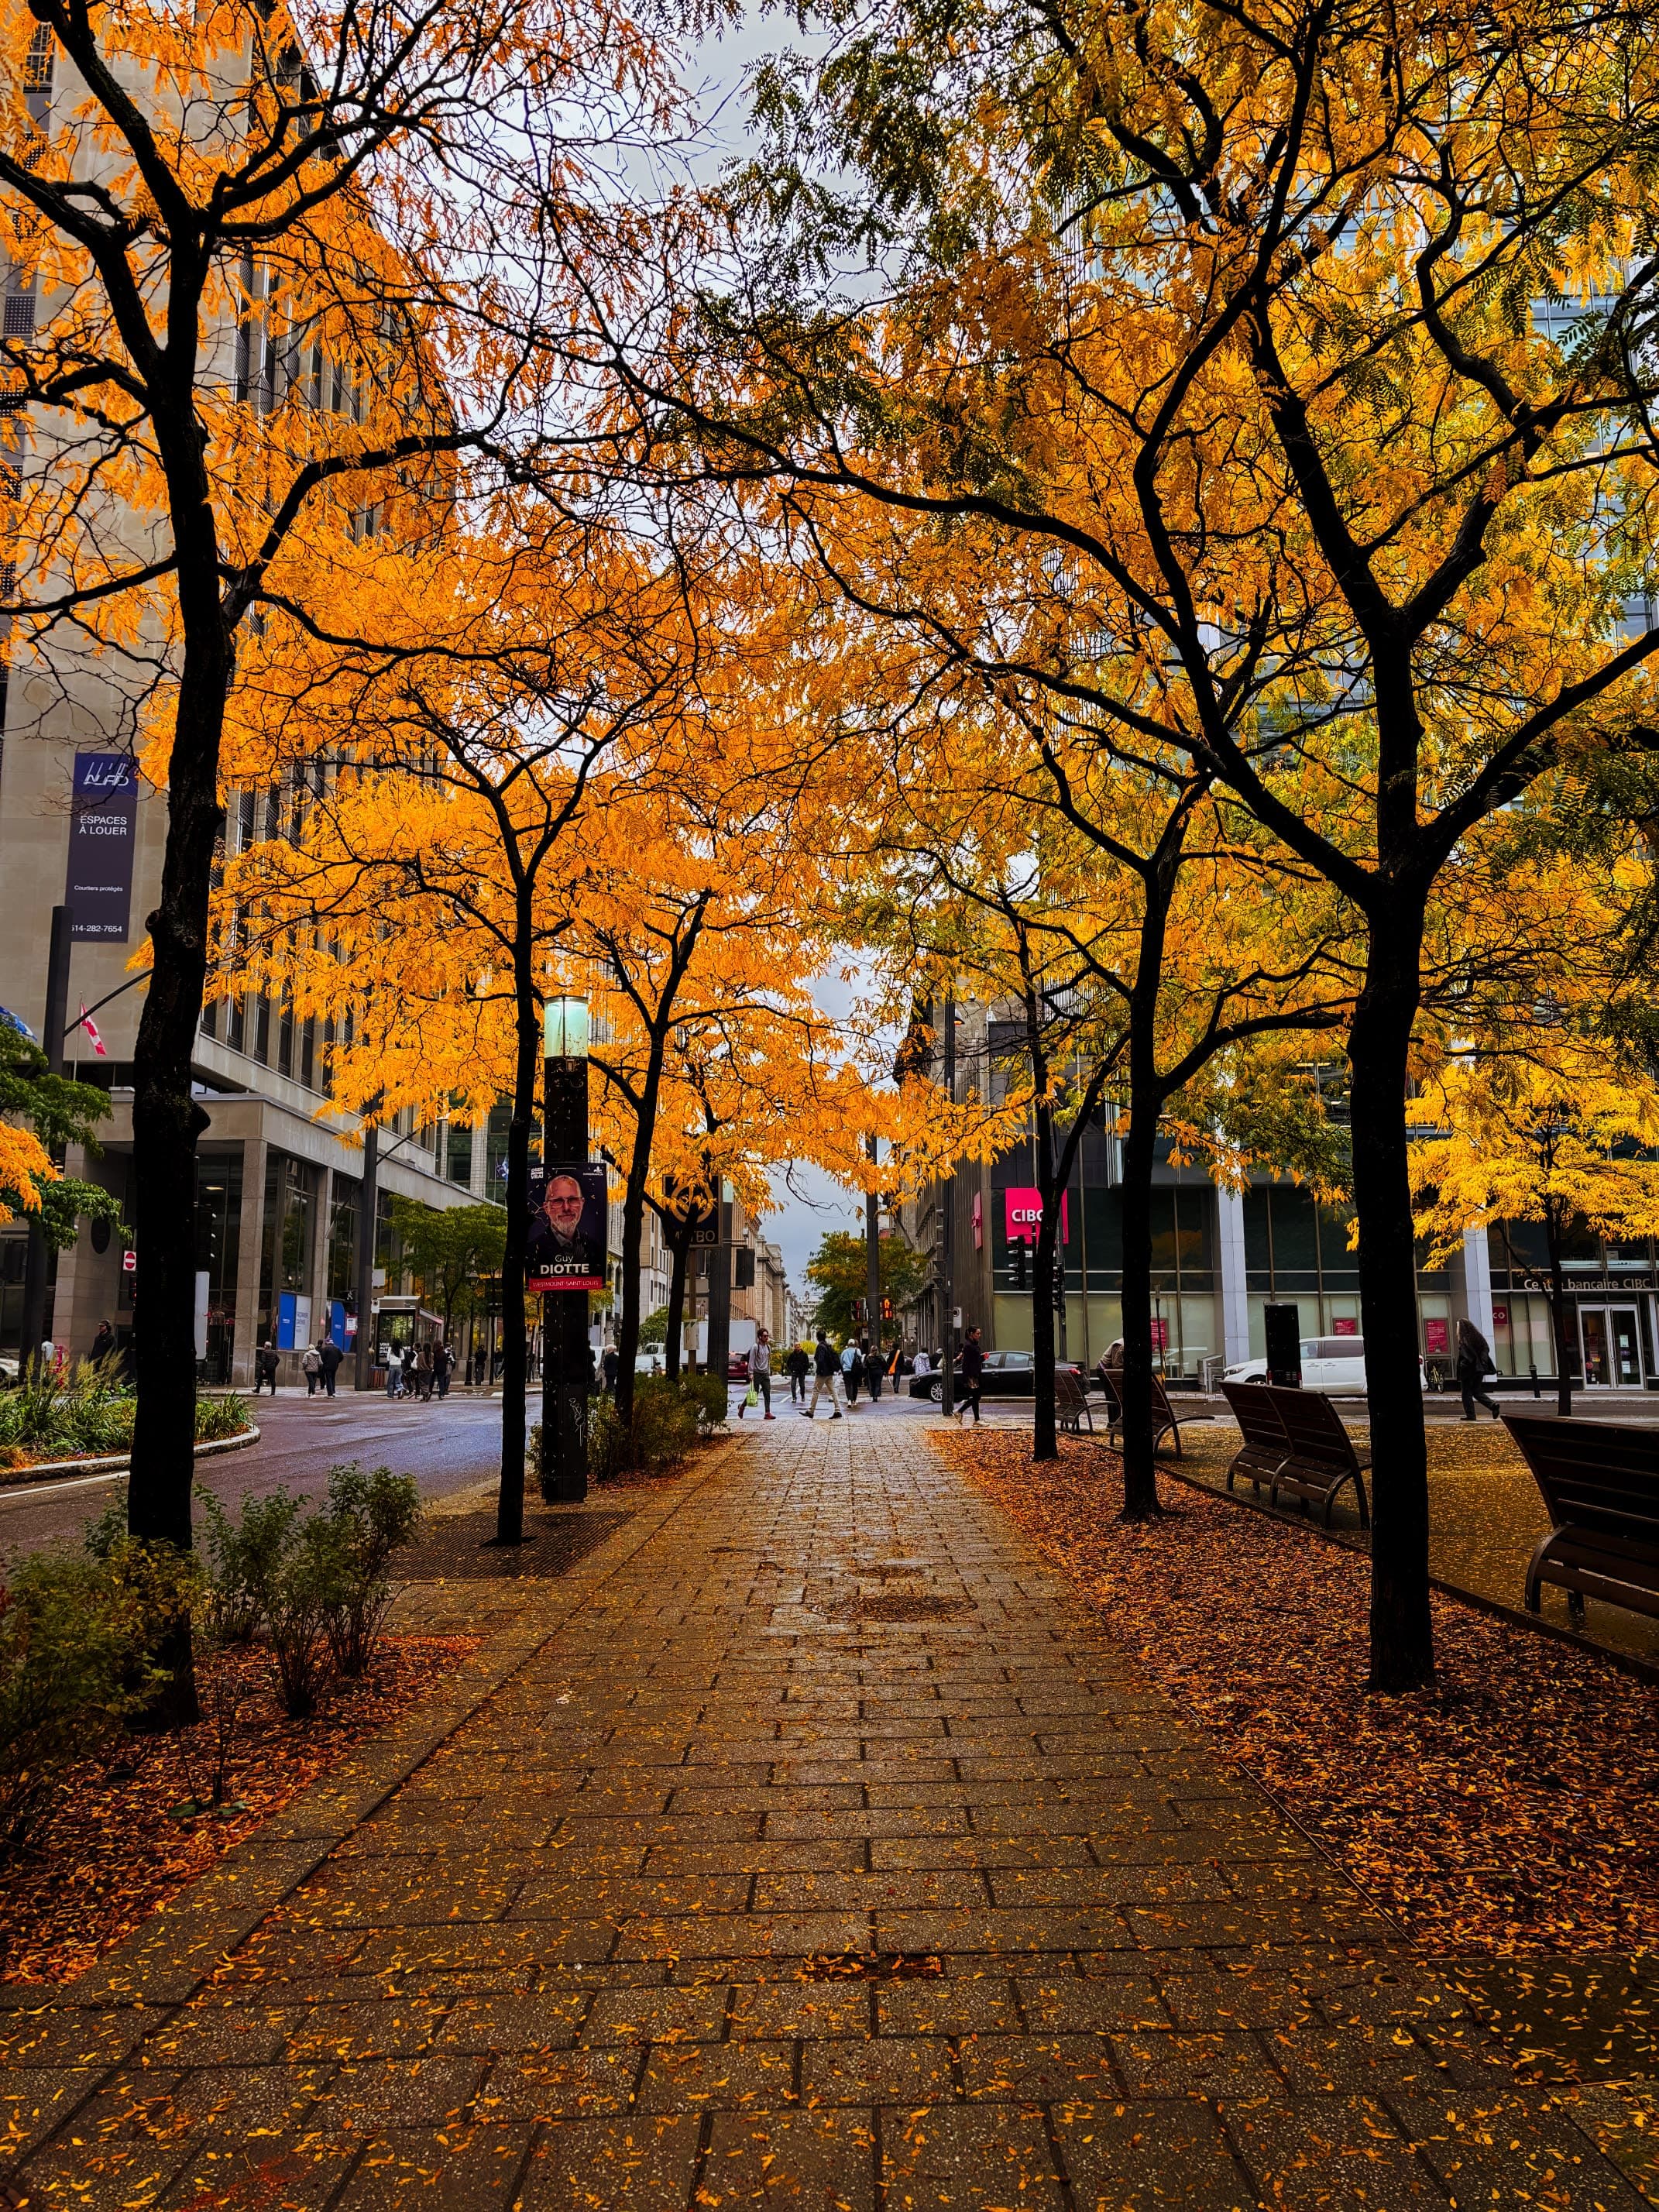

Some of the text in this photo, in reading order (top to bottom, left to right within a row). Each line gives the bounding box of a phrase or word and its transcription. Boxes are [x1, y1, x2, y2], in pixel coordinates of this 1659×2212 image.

[80, 816, 127, 825] ESPACES
[79, 824, 127, 835] À LOUER
[555, 1255, 574, 1263] Guy
[540, 1263, 589, 1275] DIOTTE
[1568, 1278, 1619, 1290] bancaire
[1623, 1278, 1651, 1290] CIBC
